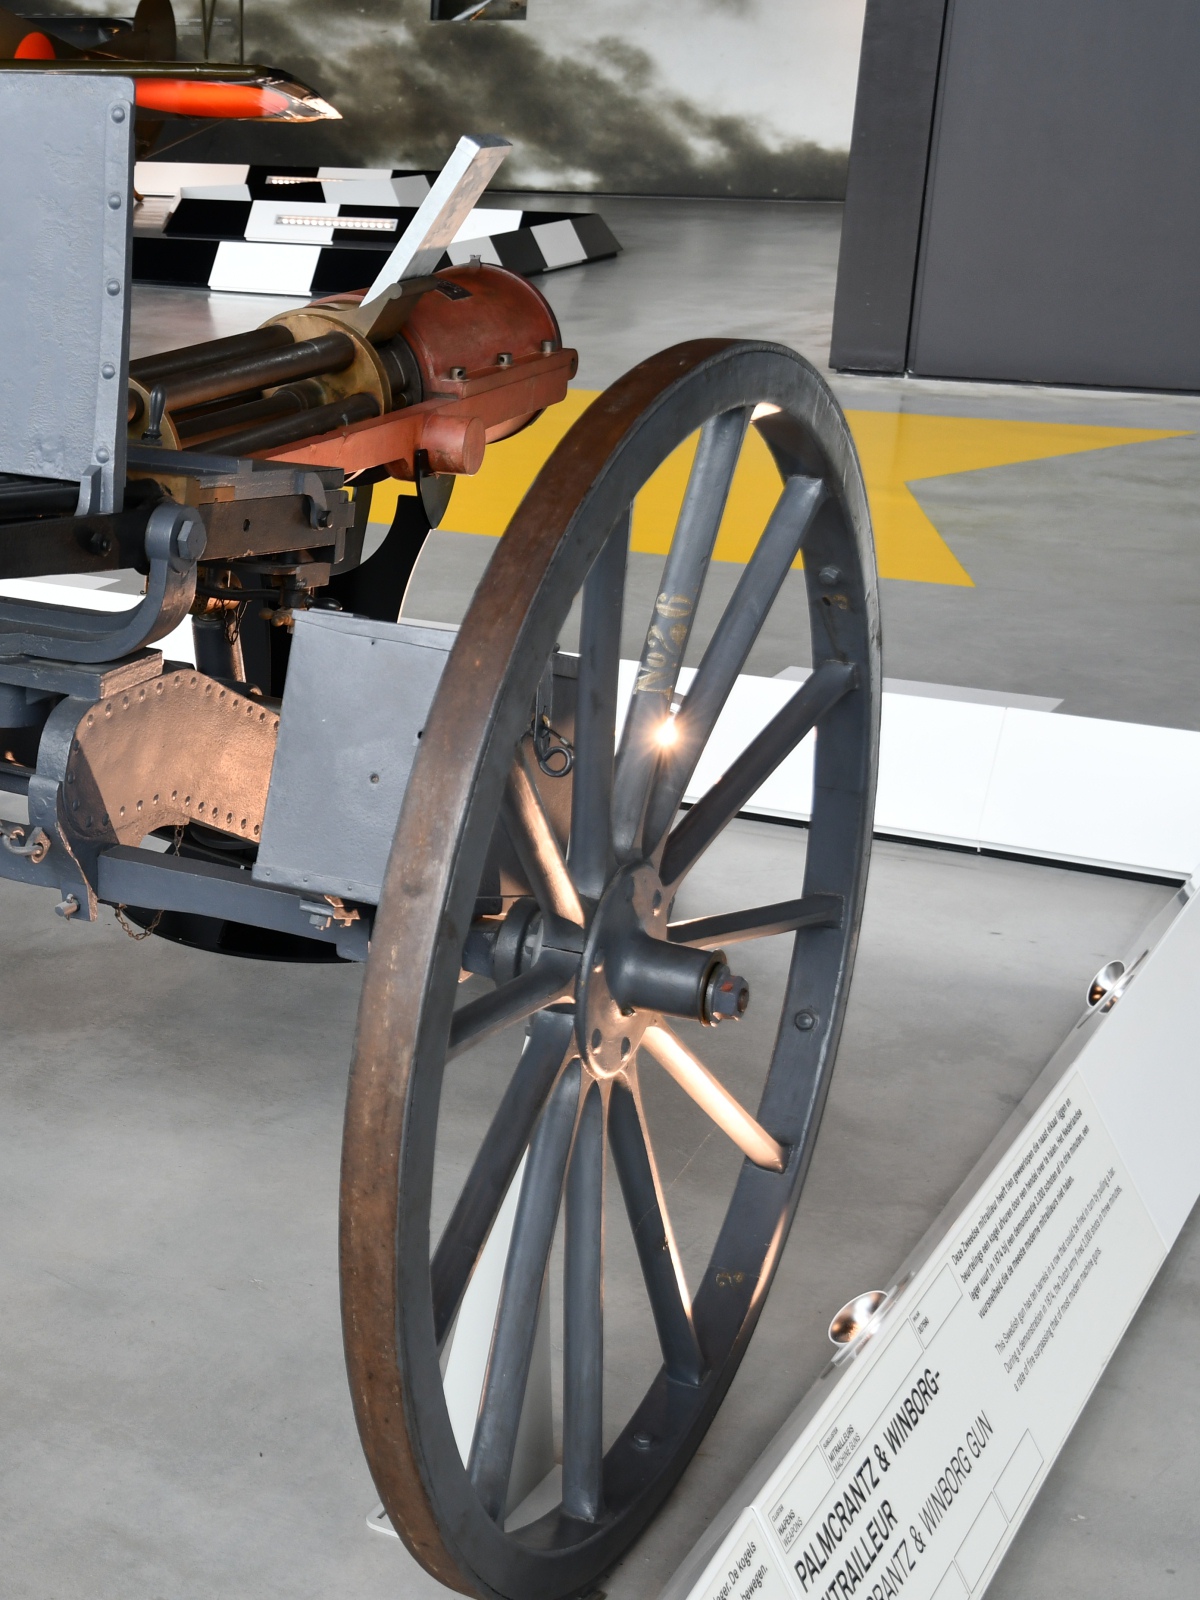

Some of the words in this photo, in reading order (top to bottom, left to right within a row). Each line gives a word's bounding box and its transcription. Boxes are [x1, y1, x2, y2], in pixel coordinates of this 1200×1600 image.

[952, 1249, 964, 1265] Deze
[961, 1226, 980, 1252] Zweedse
[978, 1200, 998, 1230] mitrailleur
[995, 1186, 1007, 1204] heeft
[1005, 1178, 1014, 1191] tien
[1013, 1150, 1034, 1184] geweerlopen
[1038, 1129, 1049, 1146] naast
[1047, 1116, 1058, 1133] elkaar
[1056, 1104, 1067, 1120] liggen
[1066, 1098, 1071, 1107] en
[960, 1250, 983, 1283] beurtelings
[982, 1240, 990, 1253] een
[987, 1224, 1000, 1244] kogel
[998, 1208, 1013, 1230] afvuren
[1011, 1196, 1021, 1211] door
[1019, 1188, 1027, 1200] een
[1025, 1170, 1038, 1191] hendel
[1037, 1161, 1045, 1175] over
[1043, 1156, 1049, 1165] te
[1056, 1133, 1064, 1146] Het
[1061, 1109, 1082, 1138] Nederlandse
[969, 1283, 981, 1301] leger
[979, 1268, 991, 1287] vuurt
[988, 1263, 995, 1273] in
[993, 1249, 1003, 1266] 1874
[1001, 1241, 1010, 1254] bij
[1007, 1234, 1015, 1247] een
[1013, 1202, 1037, 1237] demonstratie
[1044, 1171, 1058, 1192] schoten
[1056, 1163, 1061, 1174] af
[1059, 1161, 1065, 1169] in
[1063, 1152, 1071, 1164] drie
[978, 1279, 1003, 1319] vuursnelheid
[1001, 1273, 1009, 1285] die
[1007, 1265, 1014, 1276] de
[1012, 1247, 1026, 1269] meeste
[1024, 1225, 1040, 1250] moderne
[1039, 1198, 1058, 1229] mitrailleurs
[1057, 1188, 1065, 1202] niet
[1080, 1259, 1094, 1282] machine
[995, 1340, 1005, 1355] This
[1003, 1317, 1019, 1343] Swedish
[1018, 1308, 1026, 1323] gun
[1023, 1298, 1032, 1311] has
[1030, 1289, 1038, 1301] ten
[1035, 1271, 1049, 1292] barrels
[1058, 1242, 1067, 1256] that
[1065, 1228, 1075, 1246] could
[1072, 1224, 1079, 1234] be
[1004, 1351, 1019, 1374] During
[1019, 1310, 1044, 1351] demonstration
[1040, 1305, 1047, 1314] in
[1053, 1282, 1061, 1294] the
[1058, 1268, 1070, 1286] Dutch
[1068, 1256, 1078, 1271] army
[1075, 1242, 1085, 1259] fired
[1091, 1219, 1100, 1235] shots
[1101, 1202, 1110, 1218] three
[1061, 1296, 1071, 1314] most
[1069, 1279, 1081, 1301] modern
[1050, 1315, 1059, 1331] that
[1057, 1307, 1062, 1320] of
[1026, 1356, 1035, 1369] fire
[1034, 1327, 1054, 1359] surpassing
[1017, 1372, 1025, 1387] rate
[1024, 1362, 1029, 1375] of
[828, 1424, 854, 1463] MITRAILLEURS
[833, 1446, 851, 1473] MACHINE
[849, 1433, 860, 1450] GUNS
[794, 1457, 880, 1593] PALMCRANTZ
[874, 1444, 890, 1472] &
[883, 1369, 939, 1455] WINBORG-
[777, 1509, 795, 1536] WAPENS
[873, 1538, 916, 1600] RANTZ
[910, 1525, 926, 1553] &
[918, 1447, 972, 1536] WINBORG
[966, 1410, 993, 1458] GUN
[783, 1517, 803, 1547] WEAPONS
[825, 1500, 898, 1600] TRAILLEUR
[713, 1582, 731, 1600] eger.
[728, 1569, 739, 1585] De
[736, 1542, 756, 1573] kogels
